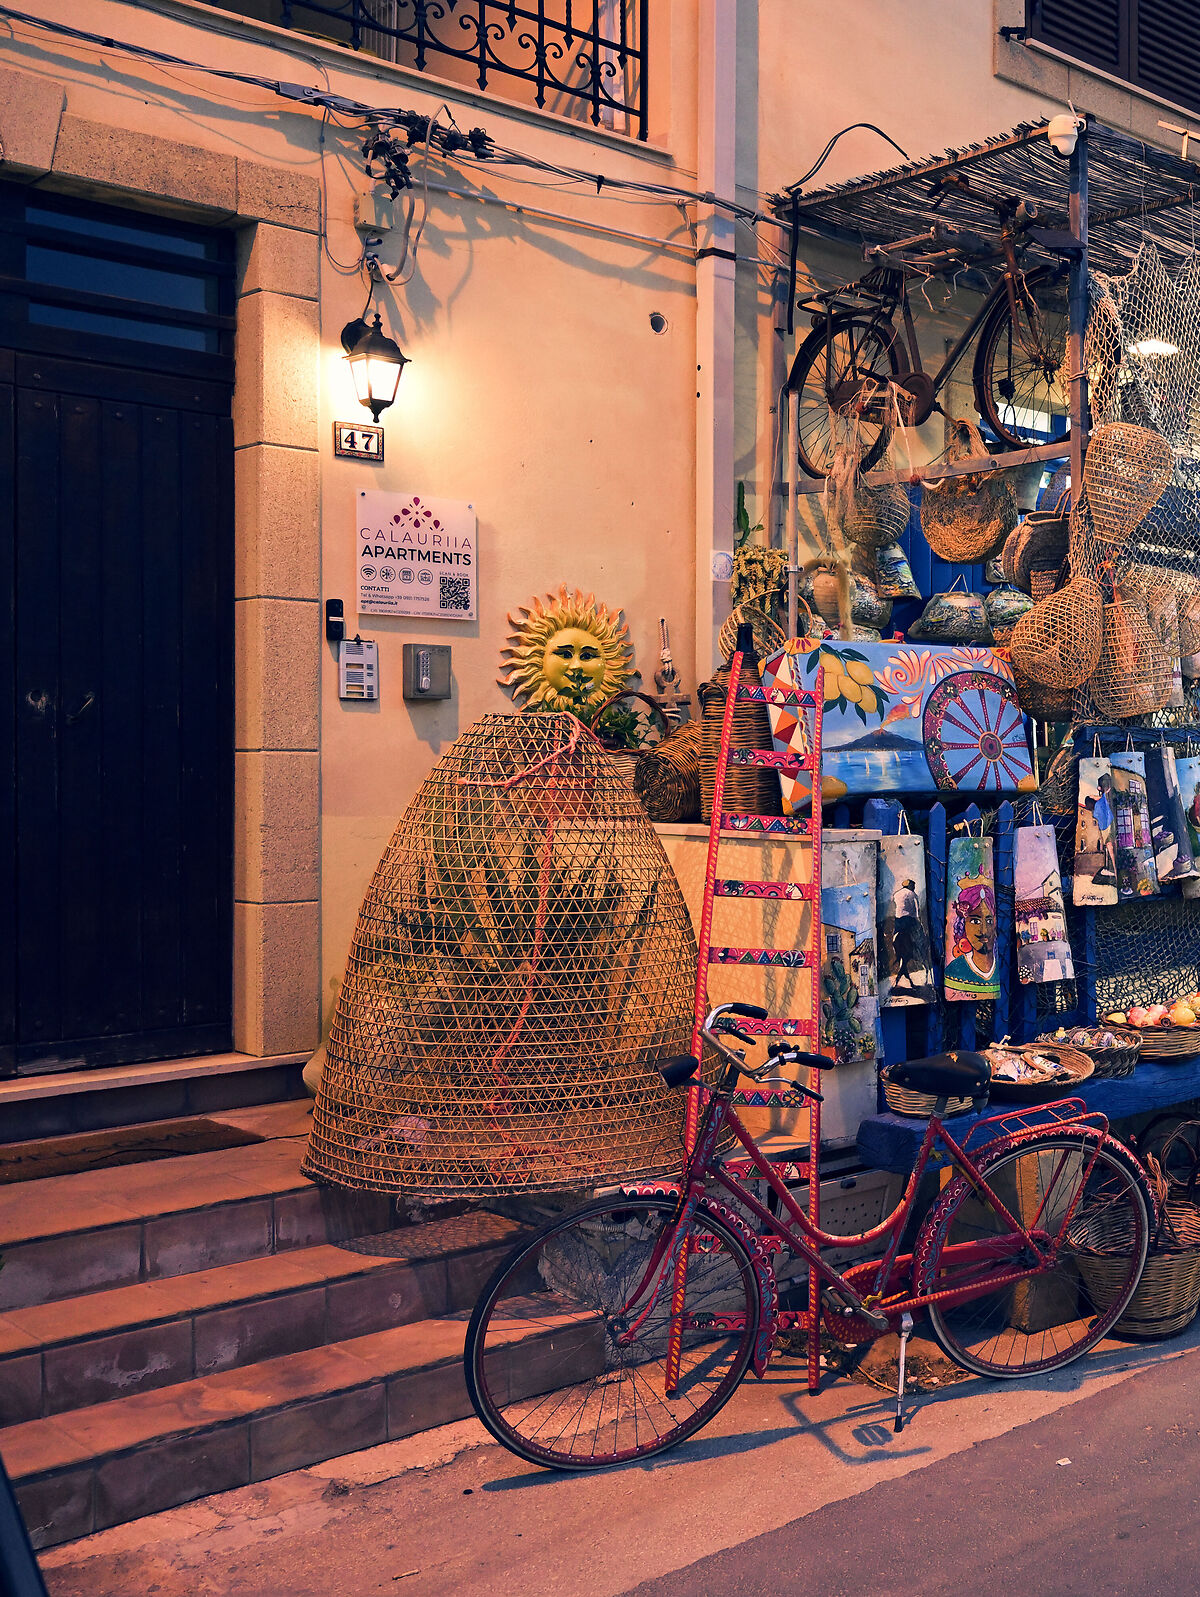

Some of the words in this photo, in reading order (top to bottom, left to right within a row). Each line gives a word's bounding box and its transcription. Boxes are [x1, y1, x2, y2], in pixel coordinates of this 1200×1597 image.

[344, 431, 375, 451] 47
[360, 527, 472, 549] CALAURIIA
[361, 545, 472, 566] APARTMENTS
